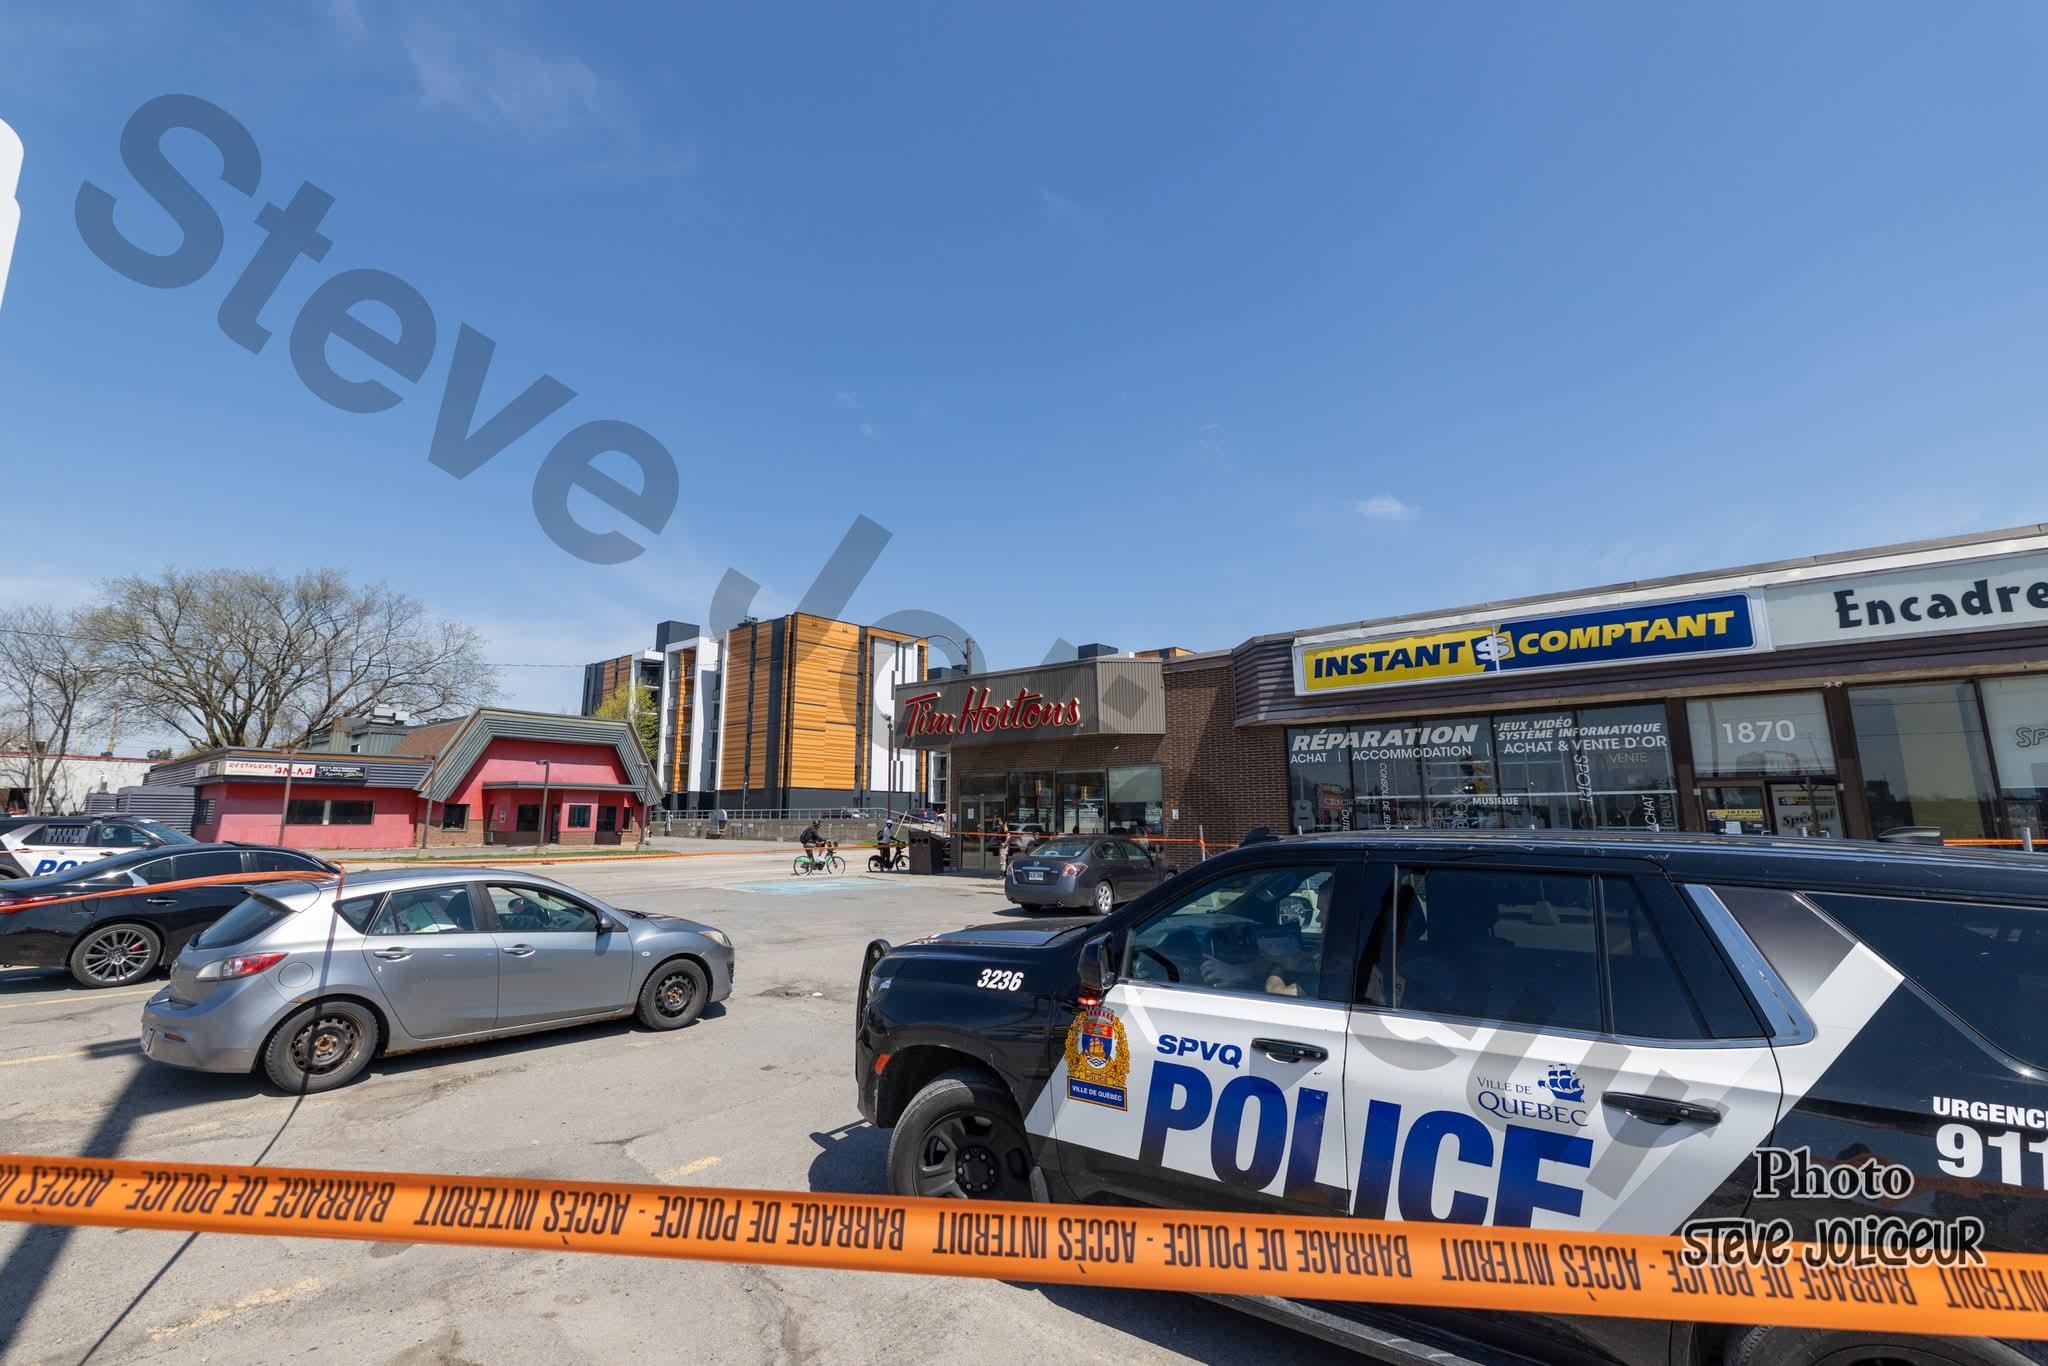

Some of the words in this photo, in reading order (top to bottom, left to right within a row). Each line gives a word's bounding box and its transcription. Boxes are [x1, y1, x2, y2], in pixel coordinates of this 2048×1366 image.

[1833, 578, 2048, 628] Encadre
[1313, 641, 1466, 680] INSTANT
[1517, 610, 1734, 655] COMPTANT
[904, 691, 957, 737] Tim
[957, 686, 1080, 735] Hortons
[1498, 721, 1528, 731] JEUX
[1534, 716, 1572, 729] VIDÉO
[1558, 723, 1662, 737] INFORMATIQUE
[1722, 720, 1796, 744] 1870
[1290, 752, 1327, 764] ACHAT
[1352, 745, 1472, 761] ACCOMMODATION
[1291, 724, 1480, 751] RÉPARATION
[1504, 741, 1553, 754] ACHAT
[1558, 741, 1569, 751] &
[1571, 738, 1620, 750] VENTE
[1472, 797, 1519, 805] MUSIQUE
[1574, 754, 1593, 805] SPORT
[976, 968, 1025, 992] 3236
[1156, 1034, 1243, 1069] SPVQ
[1071, 1085, 1088, 1096] VILLE
[1088, 1088, 1097, 1097] DE
[1476, 1075, 1512, 1093] VILLE
[1515, 1082, 1533, 1096] DE
[1933, 1096, 2048, 1130] URGENC
[1139, 1060, 1594, 1228] POLICE
[125, 1170, 228, 1213] POLICE
[223, 1174, 268, 1216] DE
[265, 1177, 395, 1223] BARRAGE
[414, 1183, 540, 1231] INTERDIT
[543, 1189, 631, 1245] ACCÈS
[651, 1195, 741, 1242] POLICE
[747, 1200, 781, 1244] DE
[787, 1203, 906, 1251] BARRAGE
[932, 1211, 1047, 1259] INTERDIT
[1057, 1217, 1136, 1274] ACCÈS
[1163, 1223, 1248, 1269] POLICE
[1256, 1227, 1288, 1272] DE
[1294, 1230, 1412, 1278] BARRAGE
[1440, 1237, 1555, 1286] INTERDIT
[1560, 1243, 1641, 1301] ACCÈS
